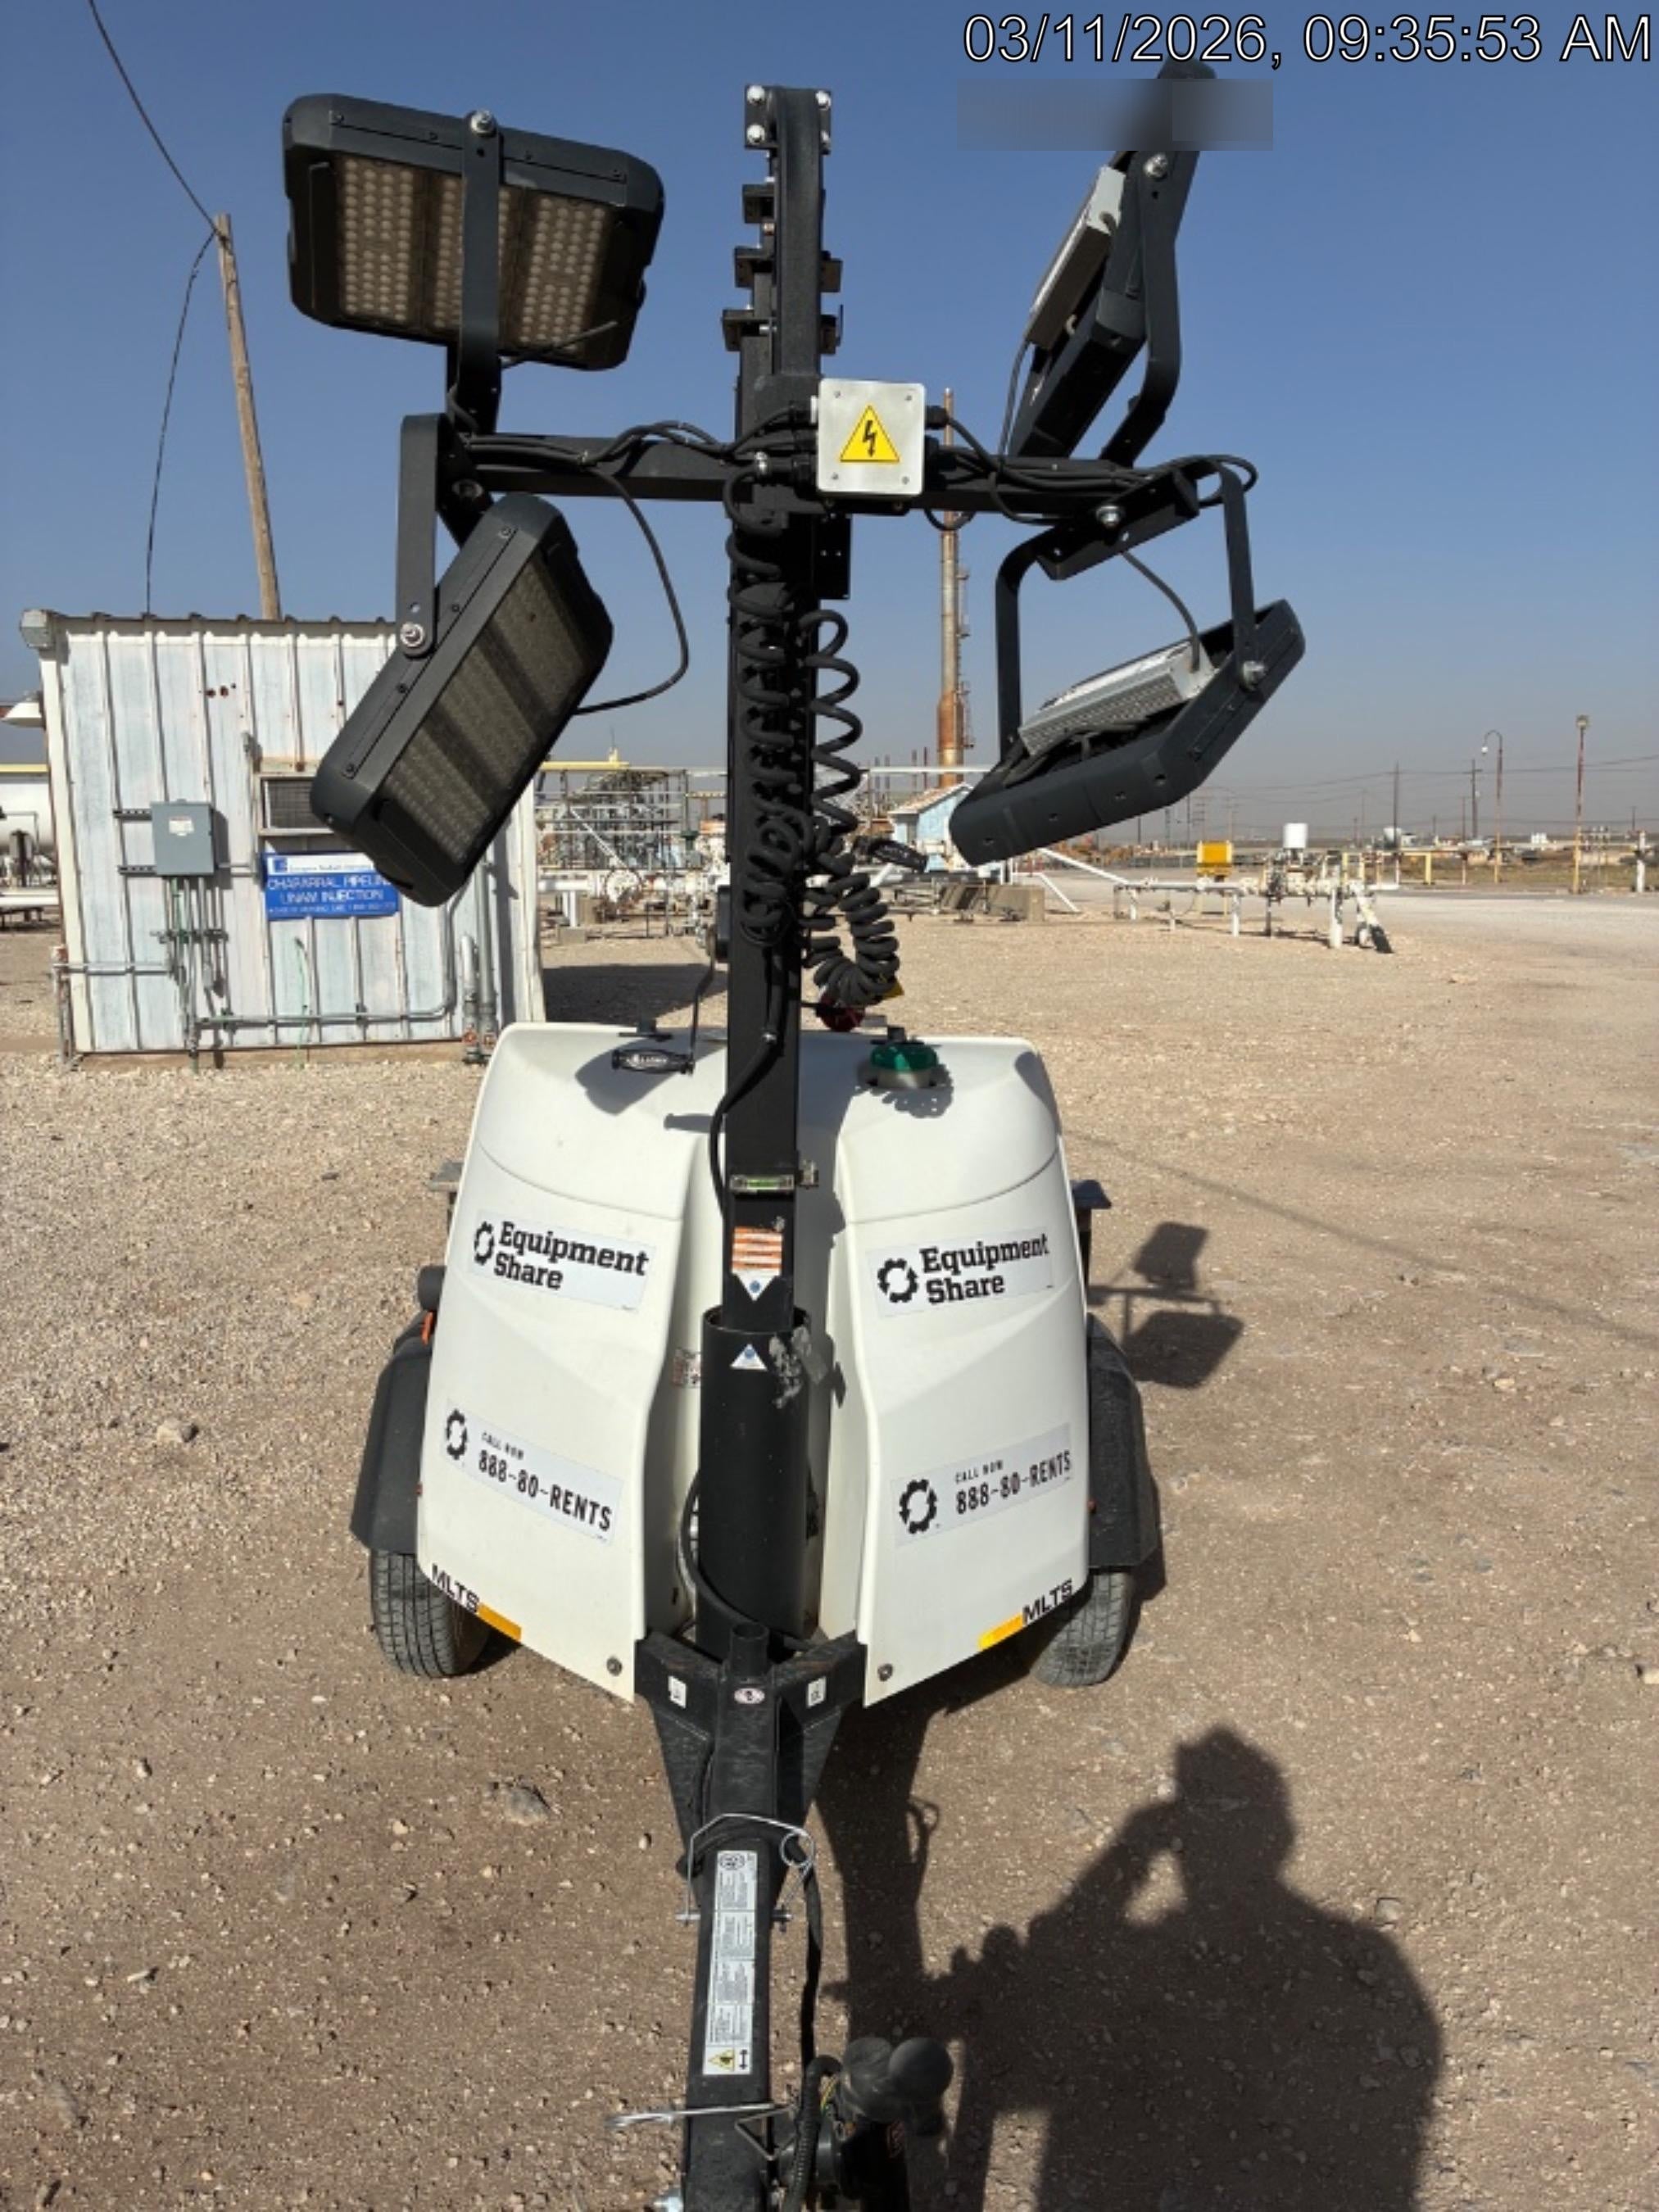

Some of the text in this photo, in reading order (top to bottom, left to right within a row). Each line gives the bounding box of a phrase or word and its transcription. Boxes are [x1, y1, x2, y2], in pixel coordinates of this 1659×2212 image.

[321, 889, 384, 903] INJECTION
[498, 1221, 650, 1276] Equipment
[919, 1232, 1049, 1276] Equipment
[493, 1252, 564, 1291] Share
[926, 1274, 1005, 1305] Share
[480, 1431, 525, 1461] CALL NOW
[478, 1448, 612, 1532] 888-80-RENTS
[955, 1459, 1004, 1484] CALL NOW
[956, 1449, 1072, 1515] 888-80-RENTS
